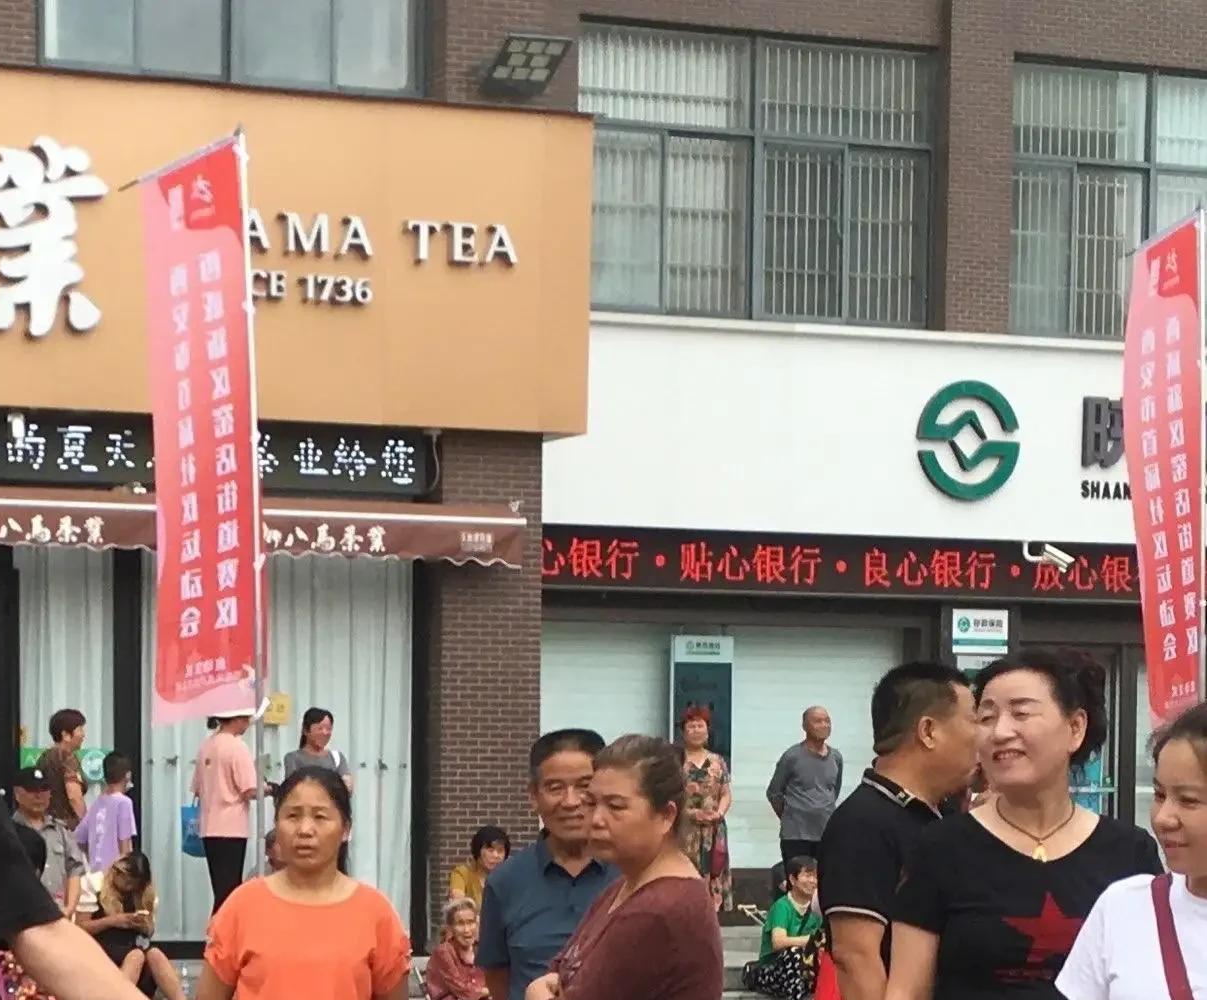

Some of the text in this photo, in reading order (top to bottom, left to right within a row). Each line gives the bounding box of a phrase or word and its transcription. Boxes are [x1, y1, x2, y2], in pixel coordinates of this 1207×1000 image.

[248, 206, 519, 265] AMA TEA
[251, 270, 374, 305] CE 1736
